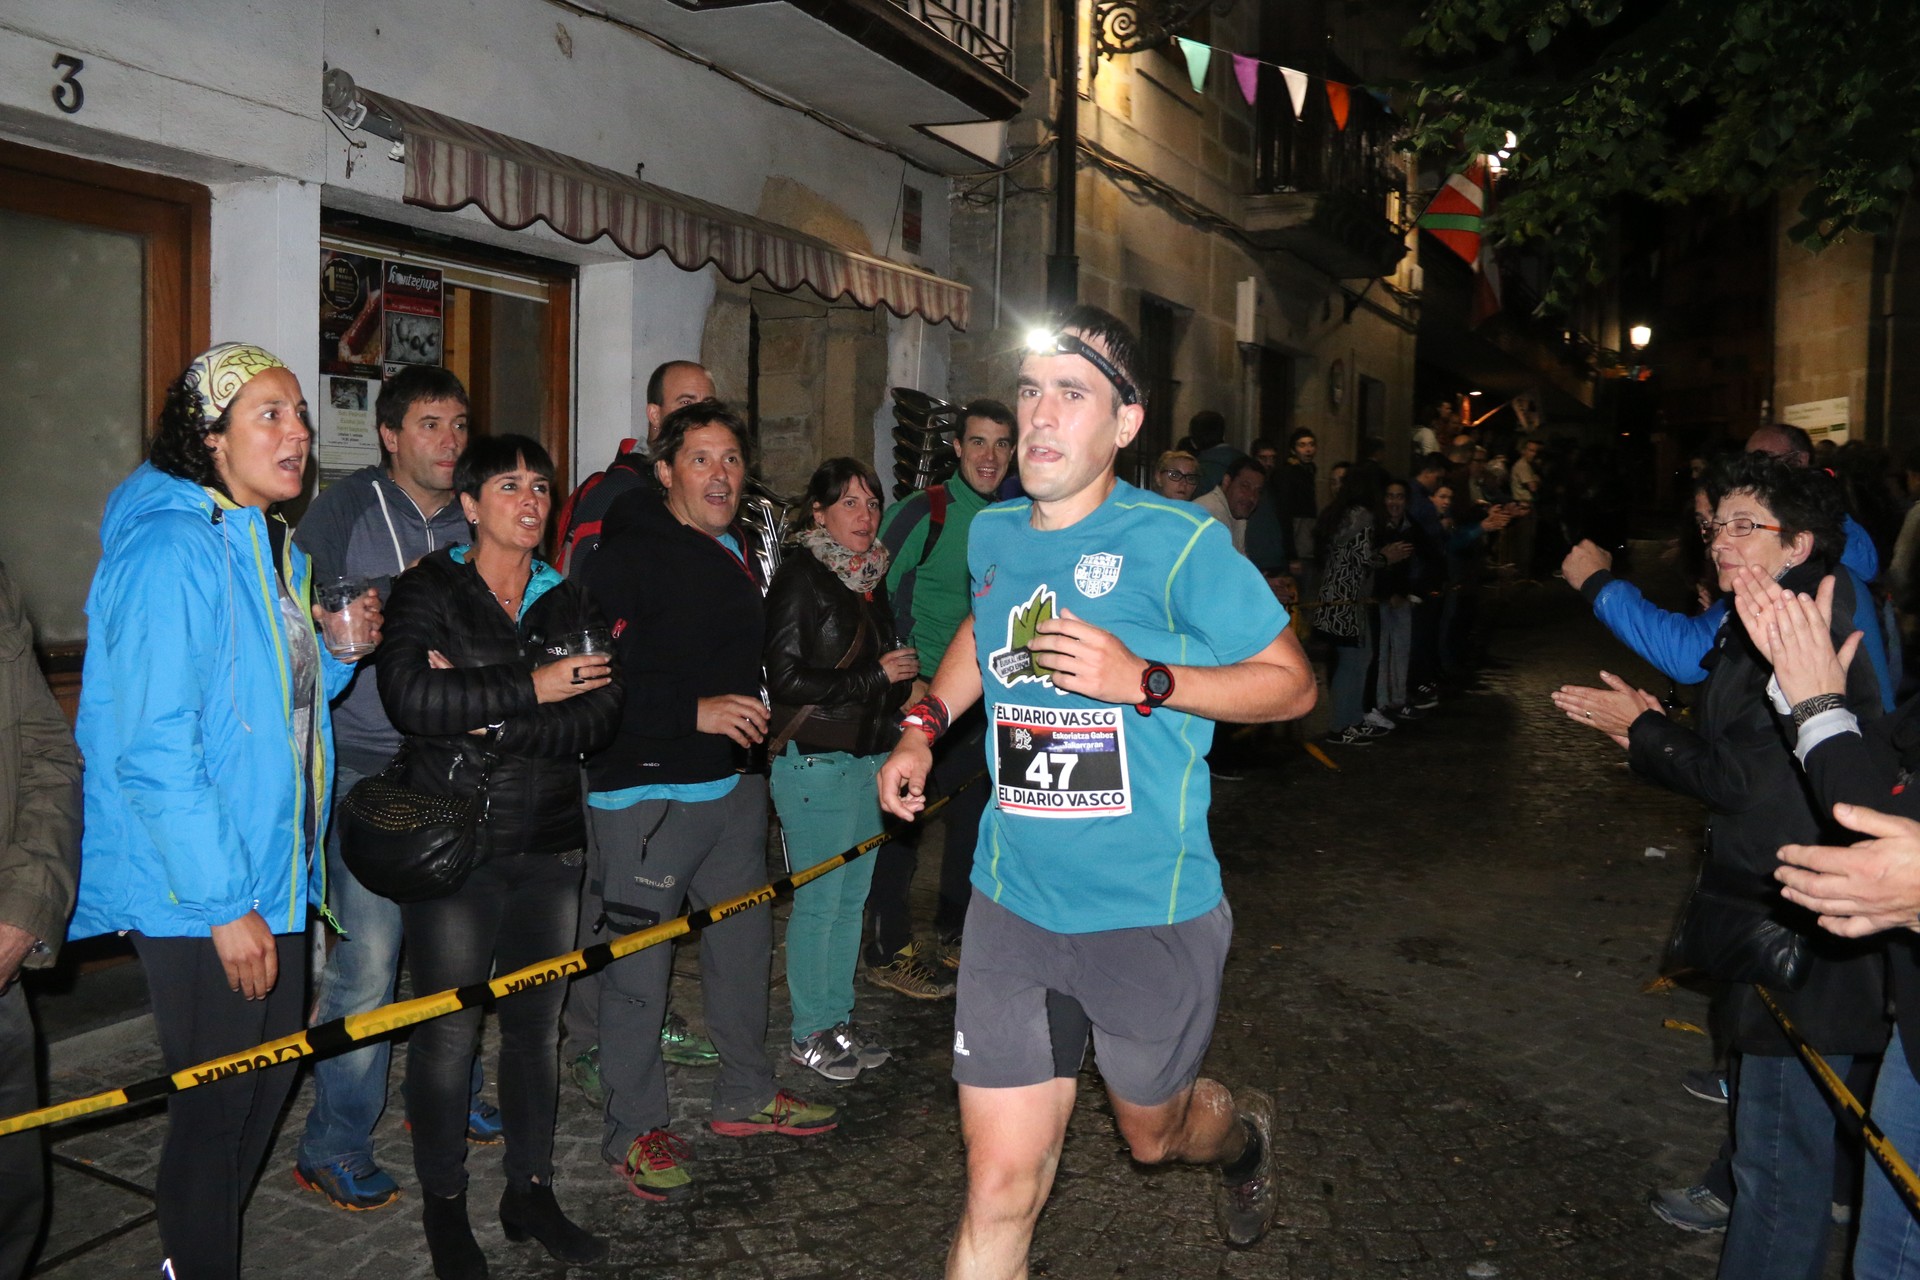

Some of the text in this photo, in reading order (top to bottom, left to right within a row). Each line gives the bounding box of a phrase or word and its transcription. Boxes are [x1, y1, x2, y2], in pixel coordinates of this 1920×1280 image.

[52, 52, 84, 114] 3
[996, 705, 1116, 726] EL DIARIO VASCO
[1052, 731, 1089, 740] Eskoriatza
[1025, 751, 1079, 790] 47
[999, 787, 1125, 807] EL DIARIO VASCO
